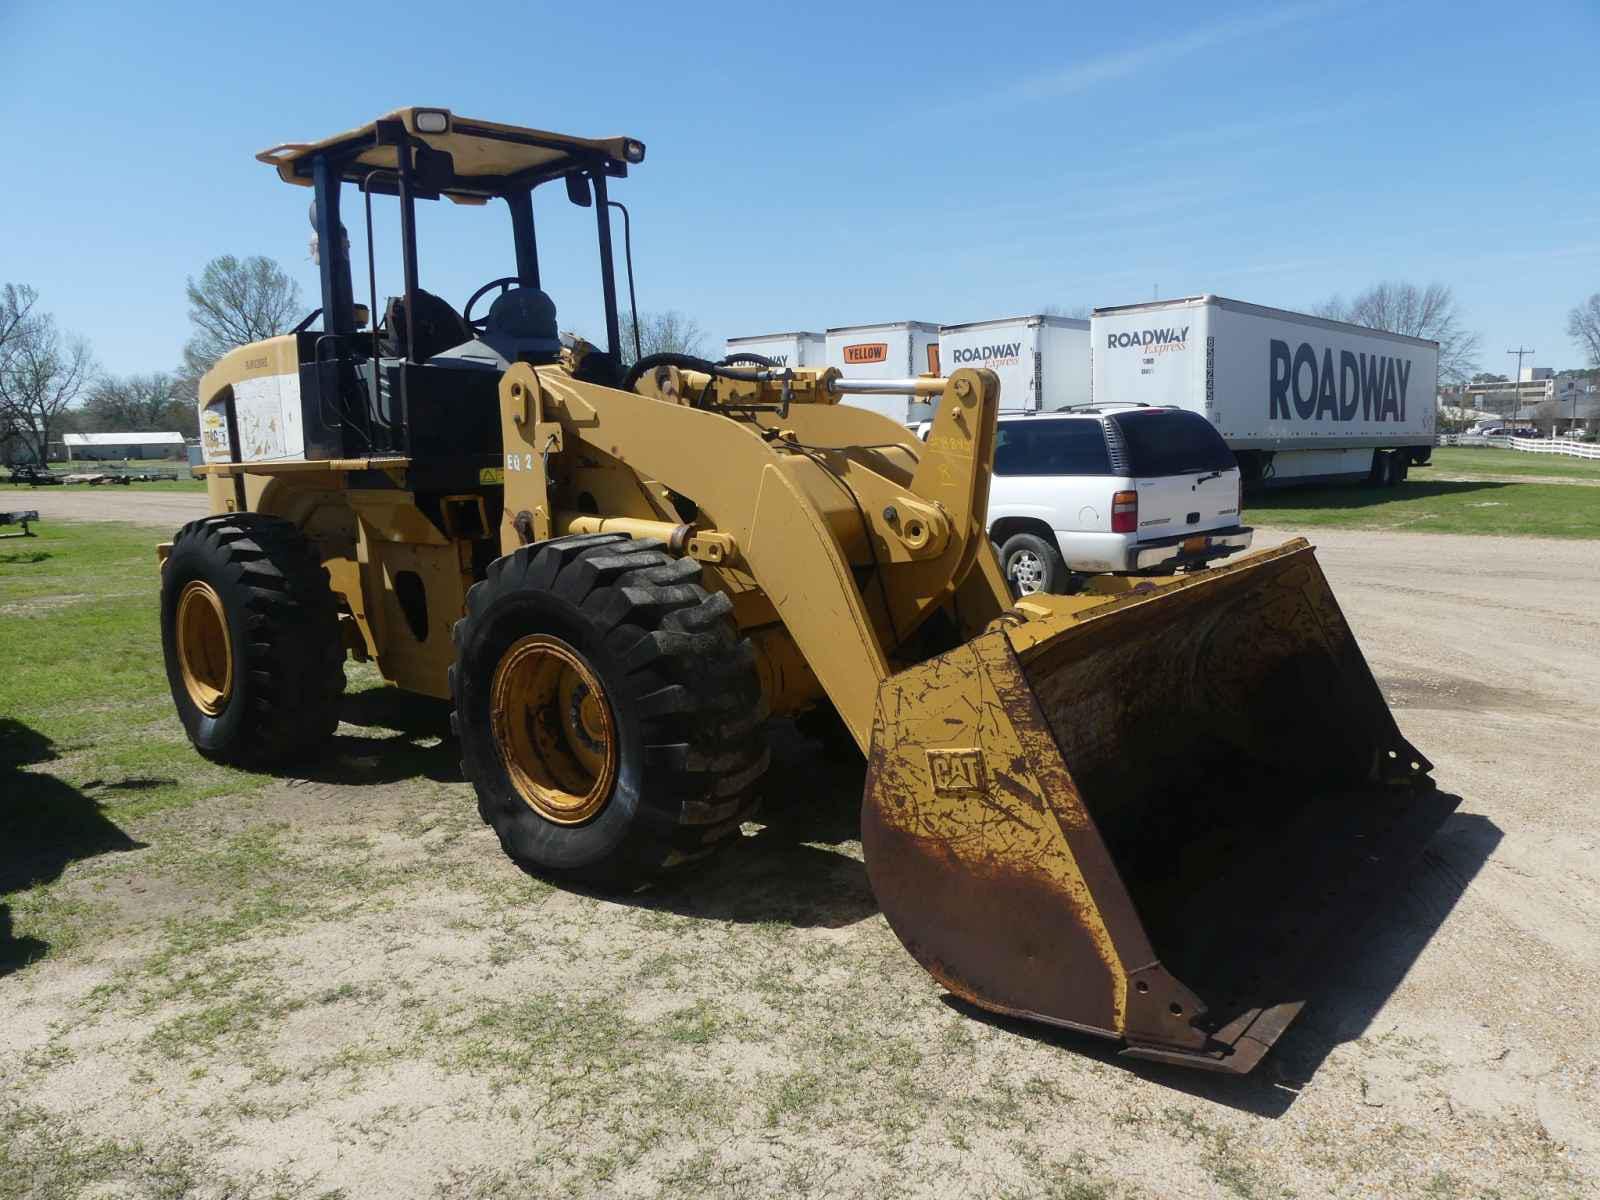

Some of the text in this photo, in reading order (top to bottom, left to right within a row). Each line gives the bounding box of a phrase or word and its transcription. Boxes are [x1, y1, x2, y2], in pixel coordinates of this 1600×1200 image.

[1107, 326, 1190, 349] ROADWAY
[848, 346, 882, 360] YELLOW
[953, 342, 1021, 363] ROADWAY
[1270, 338, 1412, 422] ROADWAY
[932, 755, 978, 788] CAT
